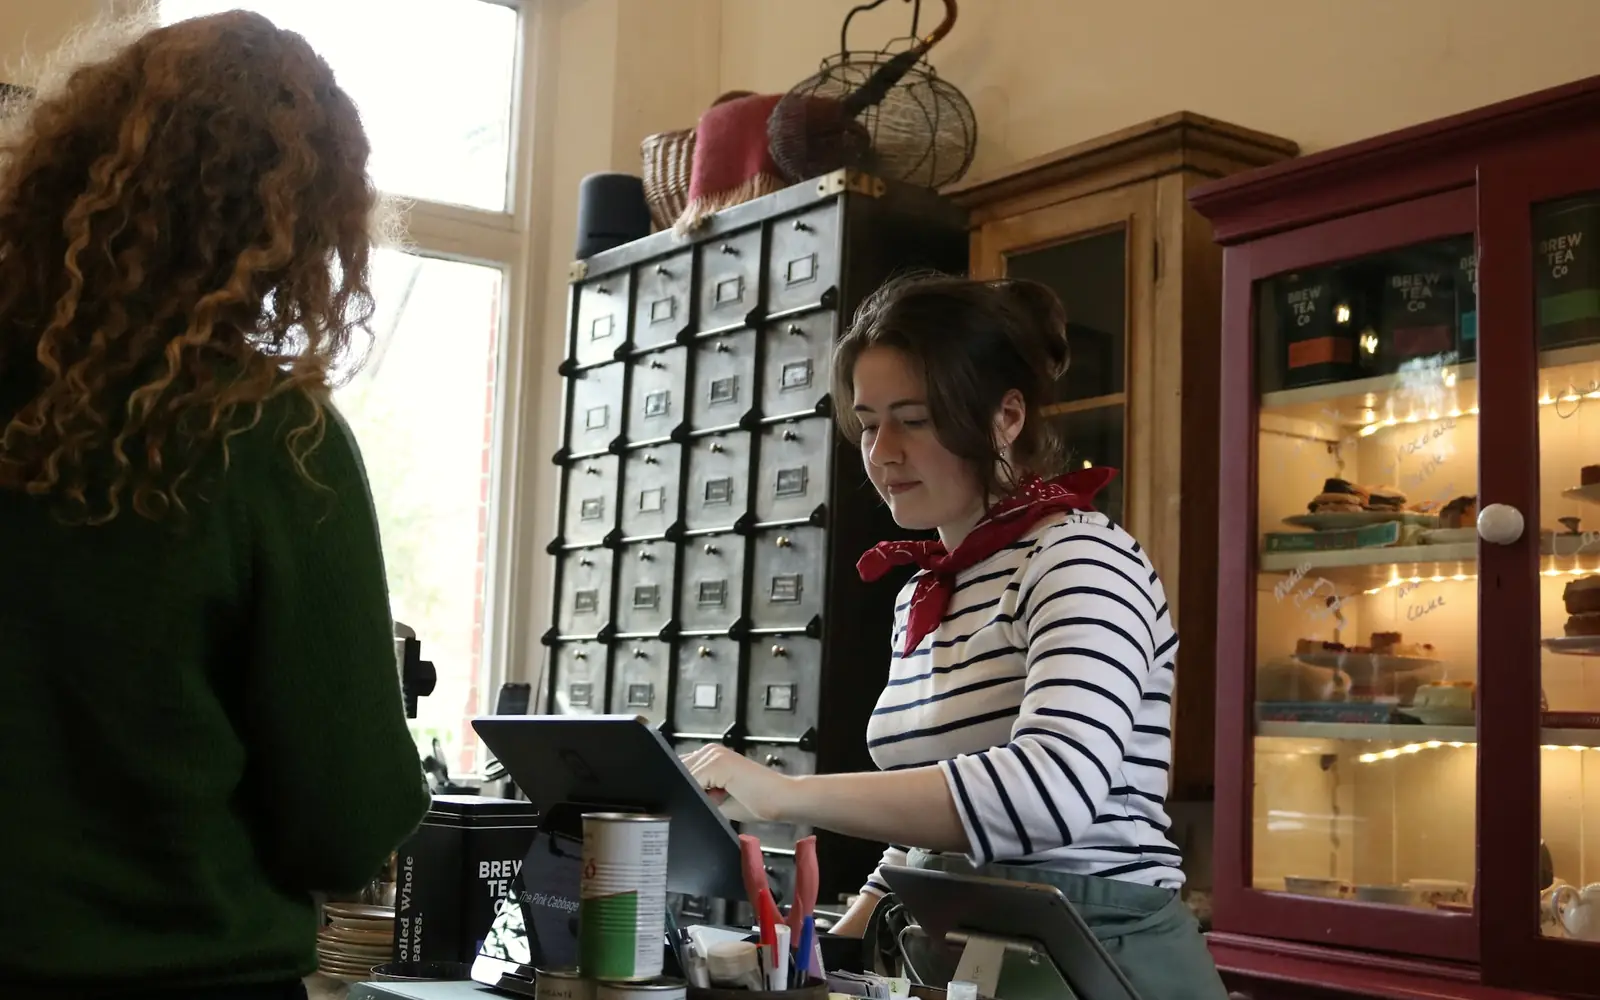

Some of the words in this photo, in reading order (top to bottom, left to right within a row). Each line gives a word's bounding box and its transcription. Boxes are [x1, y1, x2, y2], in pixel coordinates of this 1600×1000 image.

[1539, 231, 1582, 255] BREW
[1547, 249, 1574, 266] TEA
[1551, 265, 1569, 279] Co
[1391, 272, 1441, 293] BREW
[1287, 285, 1321, 304] BREW
[1400, 285, 1434, 301] TEA
[1293, 300, 1316, 316] TEA
[1407, 300, 1426, 312] Co
[1297, 315, 1311, 327] Co
[400, 856, 413, 911] Whole
[487, 879, 508, 898] TE
[519, 890, 533, 903] The
[531, 892, 549, 906] Pink
[547, 895, 580, 914] Cabbage
[399, 917, 409, 962] olled
[412, 912, 423, 962] eaves.
